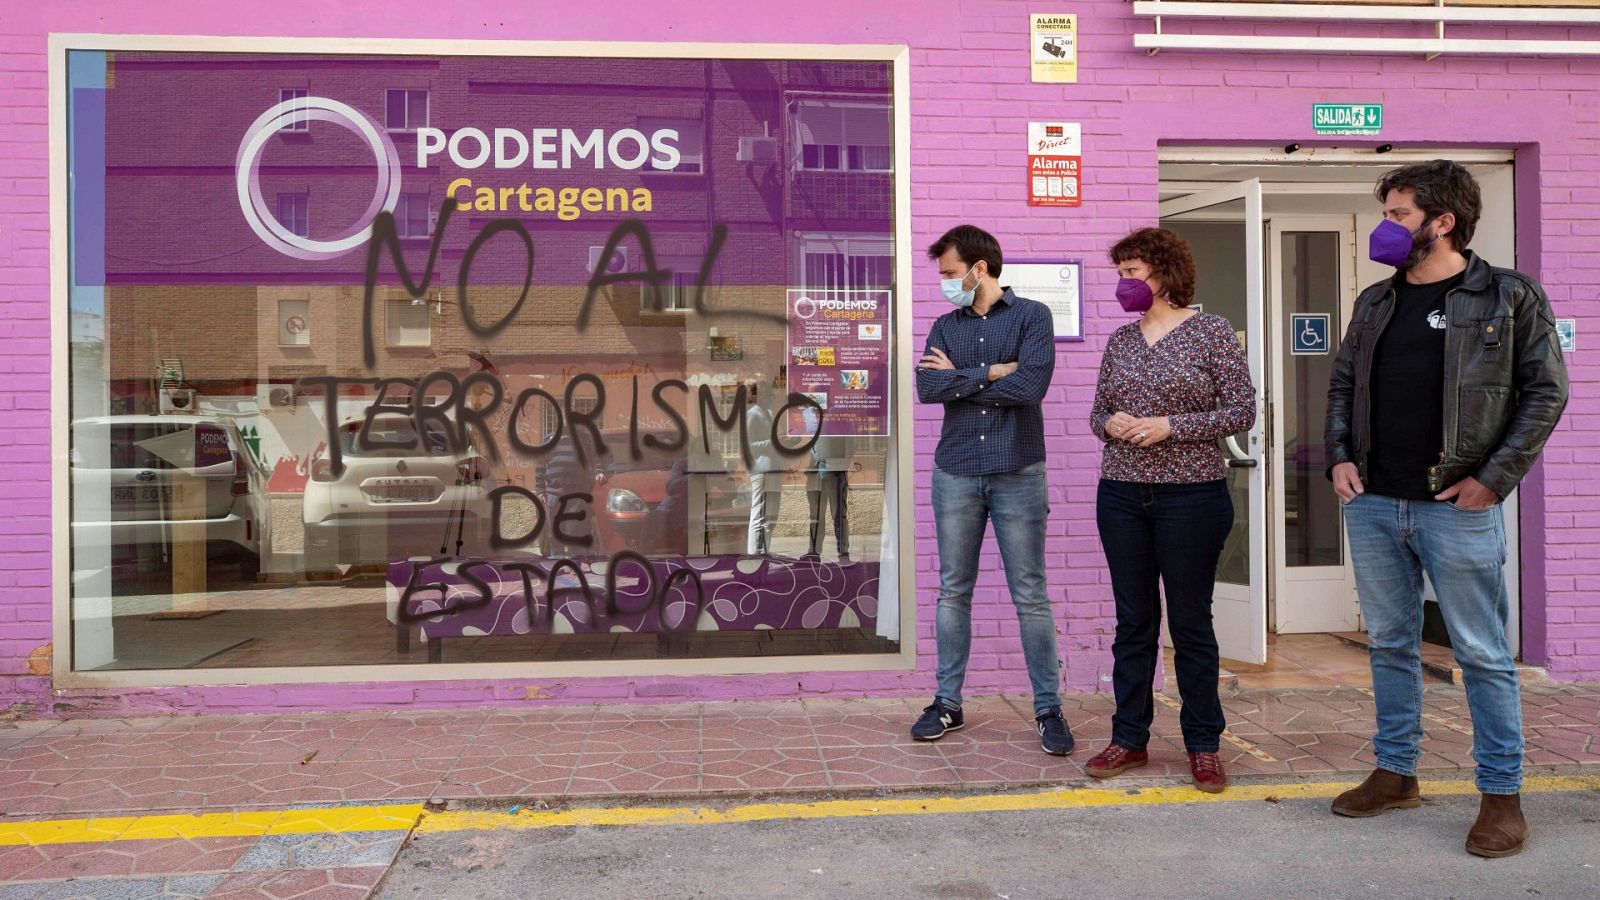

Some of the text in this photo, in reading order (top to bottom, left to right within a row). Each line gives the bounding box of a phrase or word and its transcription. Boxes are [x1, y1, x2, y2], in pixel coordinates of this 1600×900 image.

[1317, 108, 1352, 124] SALIDA
[417, 127, 680, 170] PODEMOS
[1032, 157, 1078, 170] Alarma
[446, 178, 653, 221] Cartagena
[362, 198, 790, 371] NO AL
[819, 299, 878, 310] PODEMOS
[823, 309, 875, 321] Cartagena
[300, 371, 824, 478] TERRORISMO
[486, 485, 595, 551] DE
[397, 551, 706, 633] ESTADO
